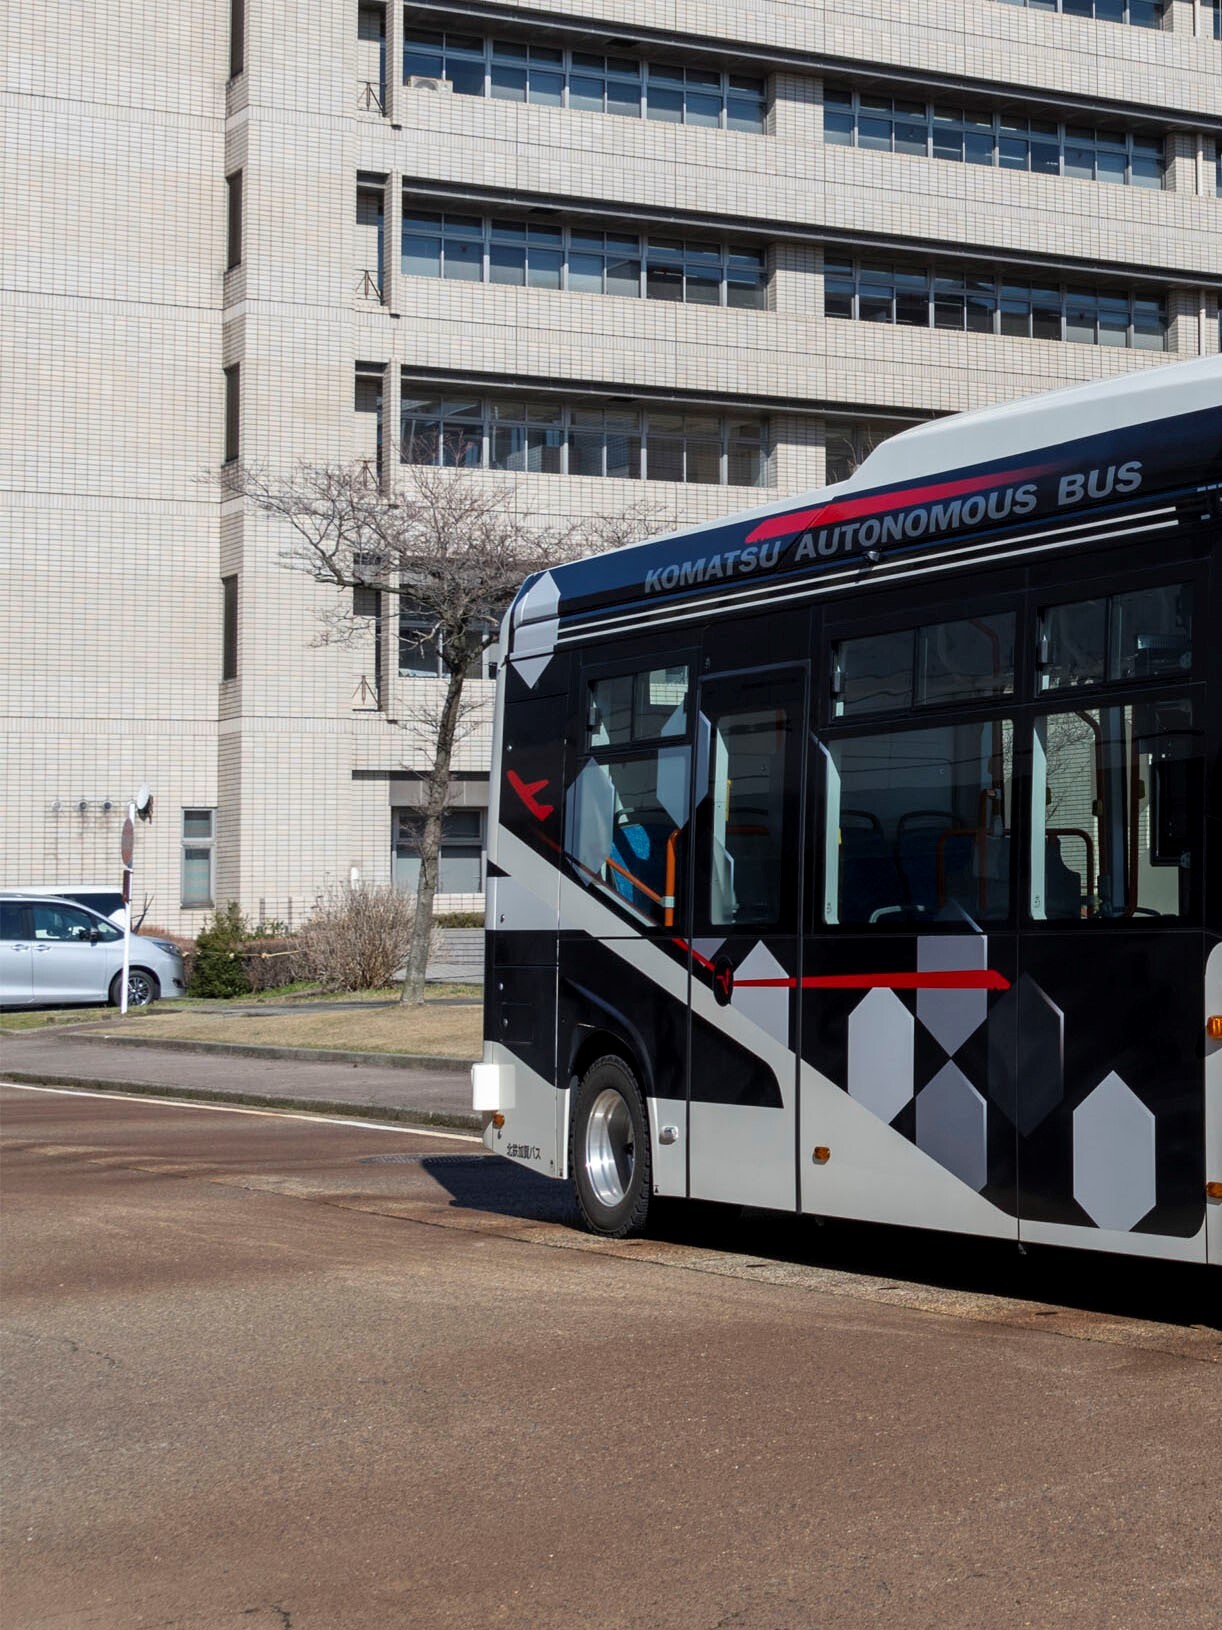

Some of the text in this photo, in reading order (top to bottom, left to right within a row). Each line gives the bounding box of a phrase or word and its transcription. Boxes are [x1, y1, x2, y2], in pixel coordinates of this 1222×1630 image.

[644, 460, 1144, 594] KOMATSU AUTONOMOUS BUS
